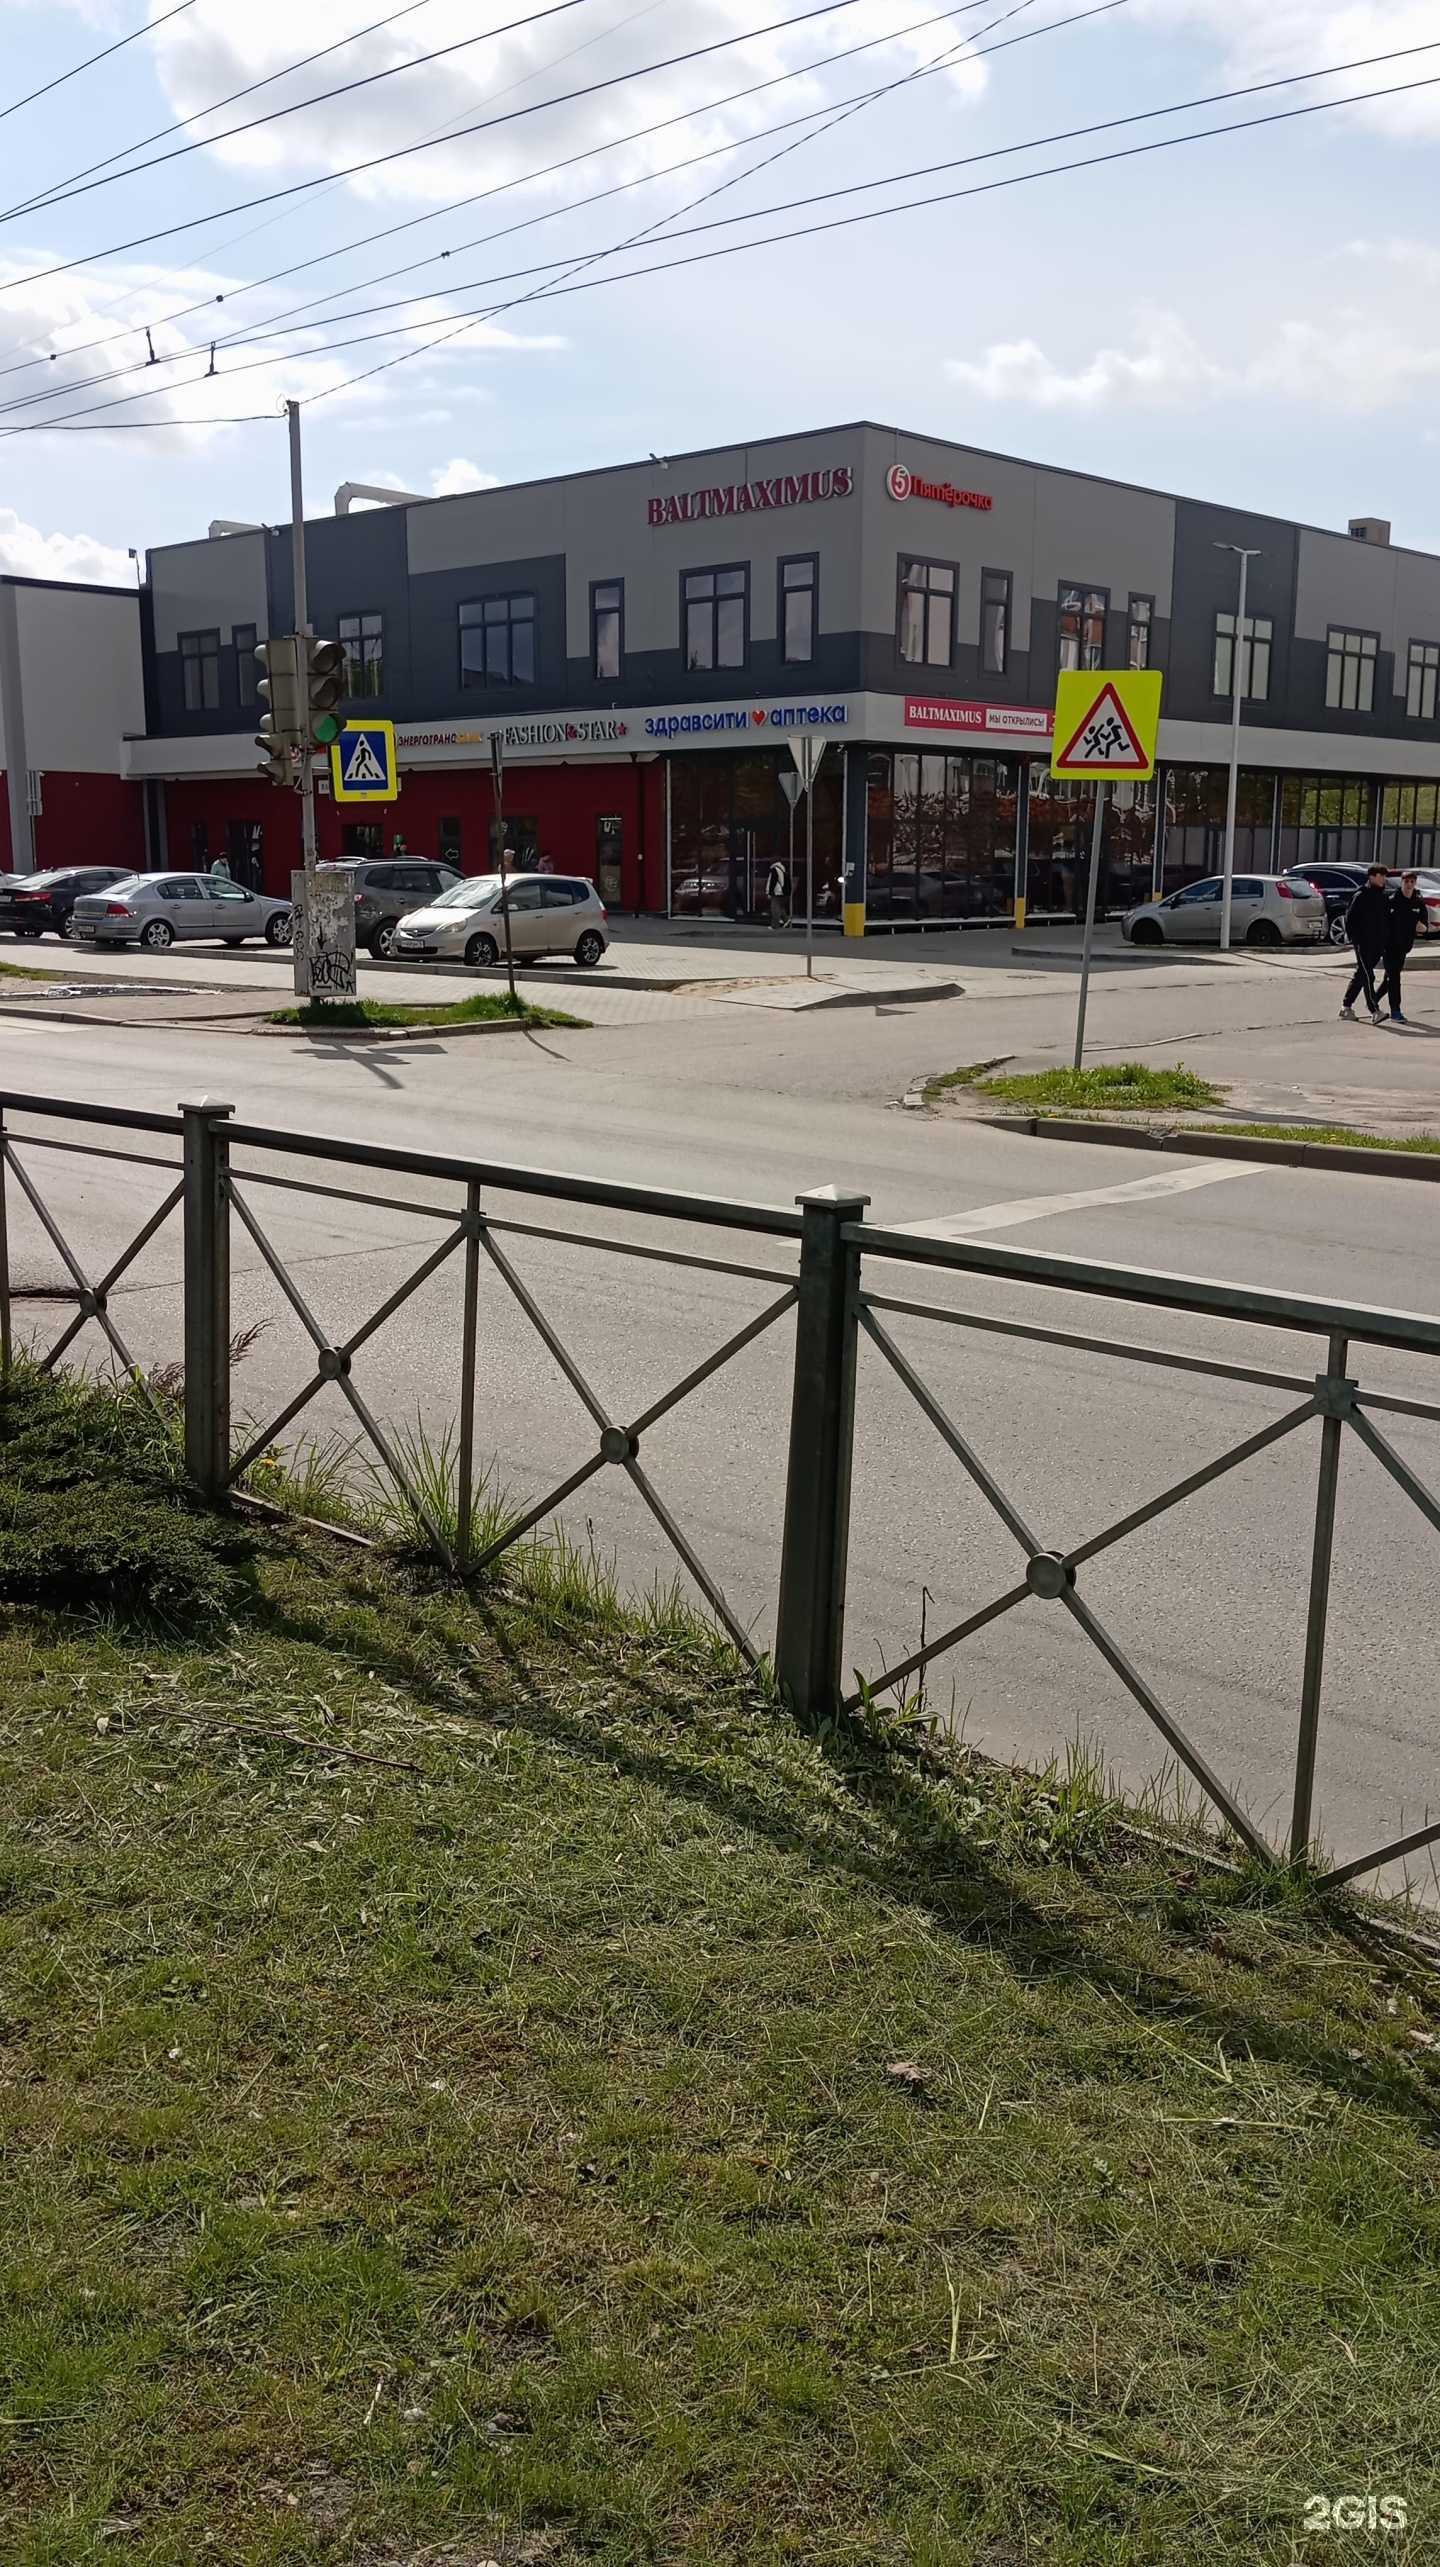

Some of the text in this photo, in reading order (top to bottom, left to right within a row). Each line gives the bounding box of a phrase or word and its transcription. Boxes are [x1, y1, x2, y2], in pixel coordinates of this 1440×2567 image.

[648, 467, 853, 526] BALTMAXIMUS
[911, 475, 993, 510] Пятёрочка
[645, 704, 848, 739] здравсити аптека
[909, 705, 982, 724] BALTMAXIMUS
[989, 714, 1000, 724] МЫ
